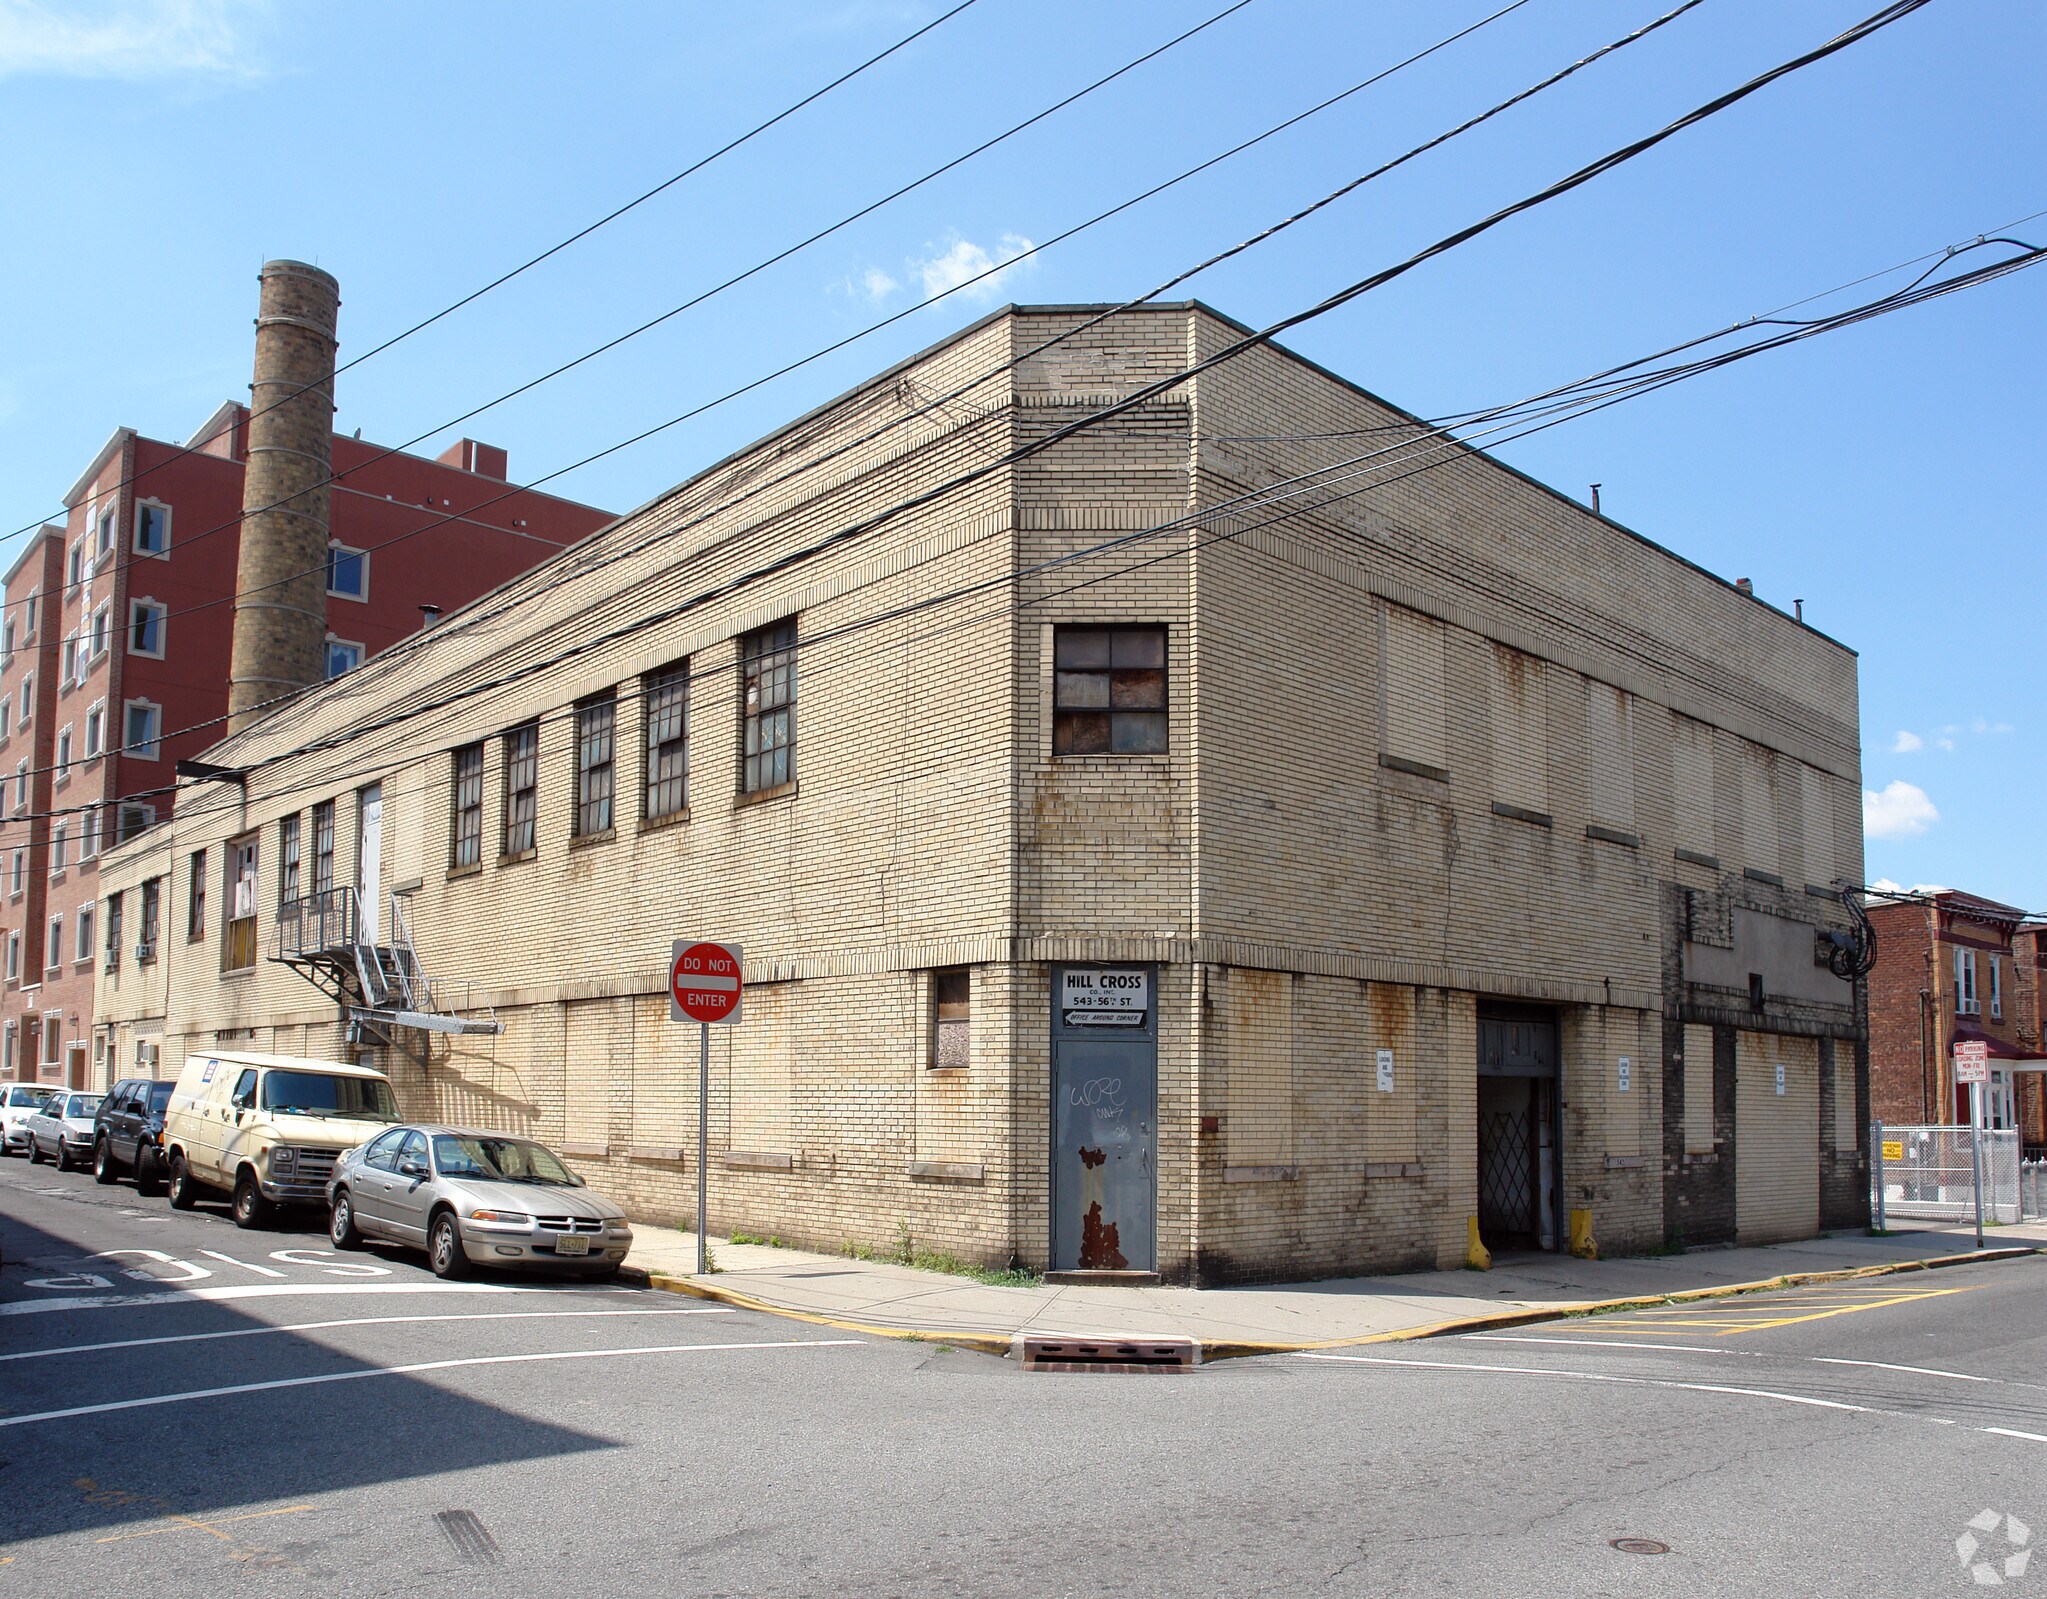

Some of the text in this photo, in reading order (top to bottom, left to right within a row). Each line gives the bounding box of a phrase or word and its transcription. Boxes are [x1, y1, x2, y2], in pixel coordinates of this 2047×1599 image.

[684, 957, 732, 973] DO NOT
[1067, 975, 1142, 989] HILL CROSS
[687, 993, 727, 1007] ENTER
[1955, 1045, 1963, 1053] NO
